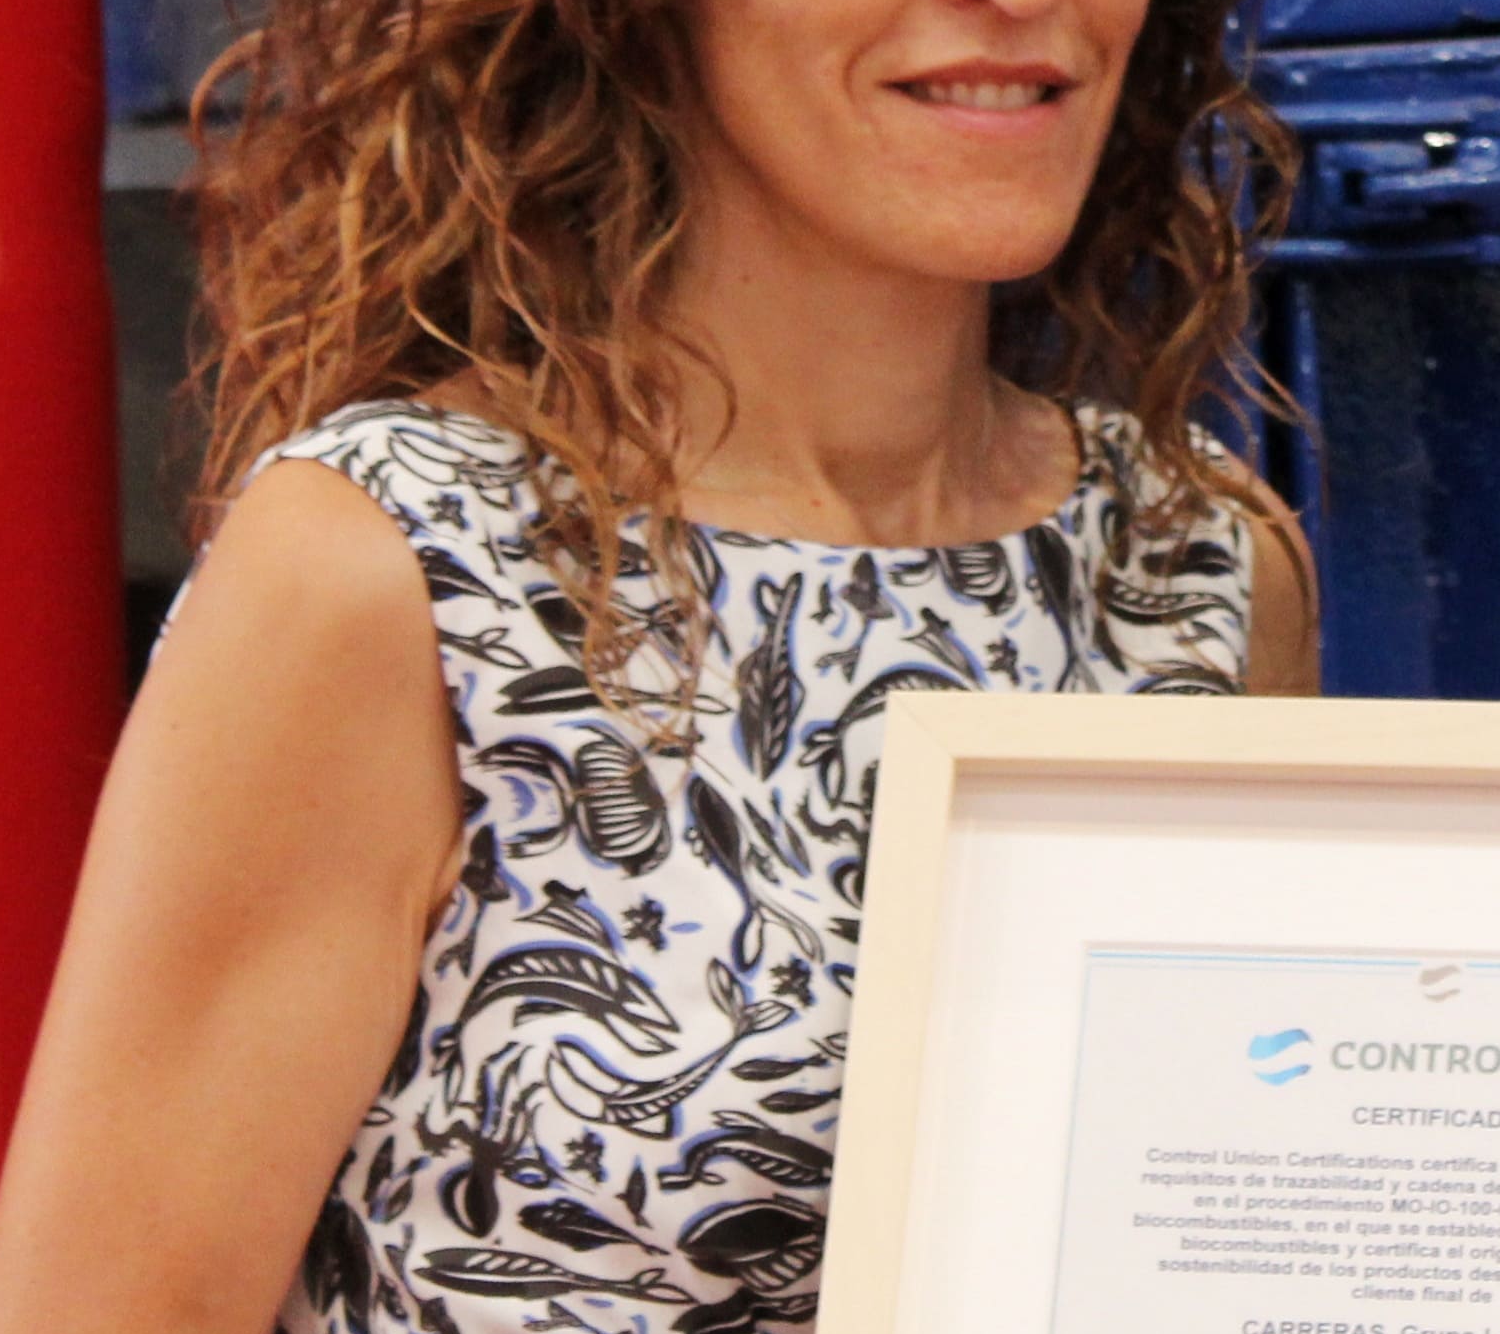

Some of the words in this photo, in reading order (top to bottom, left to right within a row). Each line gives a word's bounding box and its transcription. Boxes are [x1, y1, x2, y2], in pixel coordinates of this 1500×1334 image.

[1145, 1147, 1219, 1165] Control
[1222, 1150, 1282, 1167] Union
[1285, 1151, 1416, 1171] Certifications
[1419, 1155, 1499, 1173] certifica
[1140, 1169, 1238, 1189] requisitos
[1241, 1172, 1268, 1188] de
[1271, 1173, 1386, 1192] trazabilidad
[1388, 1180, 1402, 1196] y
[1405, 1177, 1478, 1195] cadena
[1193, 1195, 1218, 1208] en
[1221, 1193, 1241, 1209] el
[1244, 1193, 1386, 1215] procedimiento
[1303, 1220, 1329, 1233] en
[1332, 1218, 1352, 1234] el
[1354, 1222, 1393, 1238] que
[1396, 1223, 1422, 1237] se
[1179, 1235, 1342, 1256] biocombustibles
[1345, 1244, 1358, 1260] y
[1362, 1240, 1443, 1259] certifica
[1445, 1243, 1465, 1259] el
[1157, 1256, 1295, 1276] sostenibilidad
[1298, 1261, 1325, 1277] de
[1327, 1261, 1359, 1278] los
[1362, 1263, 1464, 1283] productos
[1350, 1284, 1418, 1302] cliente
[1420, 1285, 1465, 1303] final
[1468, 1287, 1493, 1304] de
